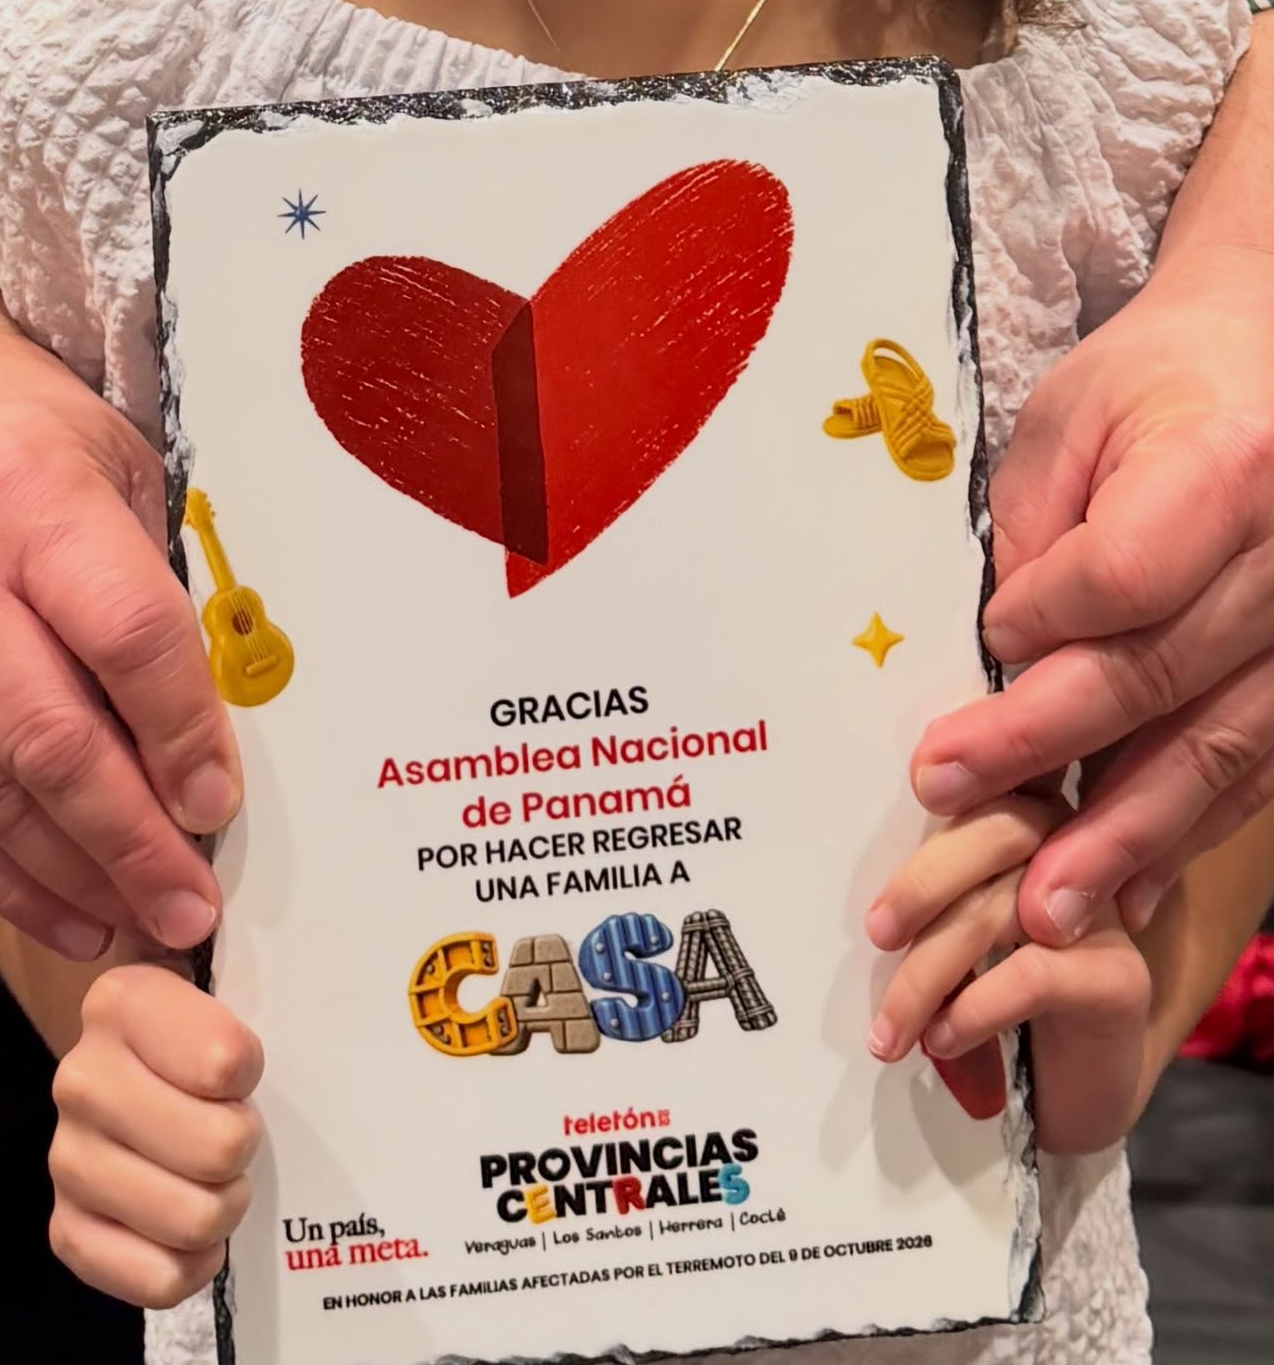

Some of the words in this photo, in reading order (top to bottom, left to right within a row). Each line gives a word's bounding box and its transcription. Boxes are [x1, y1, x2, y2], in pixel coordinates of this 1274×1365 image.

[489, 685, 650, 728] GRACIAS
[377, 743, 582, 789] Asamblea
[591, 719, 768, 768] Nacional
[461, 795, 512, 829] de
[522, 774, 692, 823] Panamá
[417, 842, 478, 872] POR
[484, 831, 585, 865] HACER
[593, 816, 743, 854] REGRESAR
[475, 874, 539, 904] UNA
[547, 862, 663, 897] FAMILIA
[669, 859, 691, 885] A
[407, 909, 778, 1057] CASA
[563, 1106, 657, 1136] teletón
[479, 1127, 759, 1189] PROVINCIAS
[496, 1162, 751, 1225] CENTRALES
[282, 1217, 325, 1243] Un
[329, 1212, 386, 1246] país,
[285, 1243, 342, 1271] una
[348, 1236, 429, 1265] meta.
[464, 1236, 537, 1256] Veraguas
[553, 1230, 580, 1245] Los
[586, 1224, 642, 1242] Santos
[659, 1217, 723, 1235] Herrera
[739, 1208, 787, 1226] Coclé
[322, 1296, 343, 1310] EN
[345, 1290, 402, 1308] HONOR
[405, 1289, 416, 1303] A
[419, 1285, 447, 1301] LAS
[450, 1279, 518, 1297] FAMILIAS
[521, 1268, 610, 1290] AFECTADAS
[614, 1264, 645, 1280] POR
[648, 1262, 663, 1277] EL
[666, 1254, 756, 1275] TERREMOTO
[759, 1250, 786, 1265] DEL
[801, 1246, 821, 1261] DE
[823, 1237, 893, 1259] OCTUBRE
